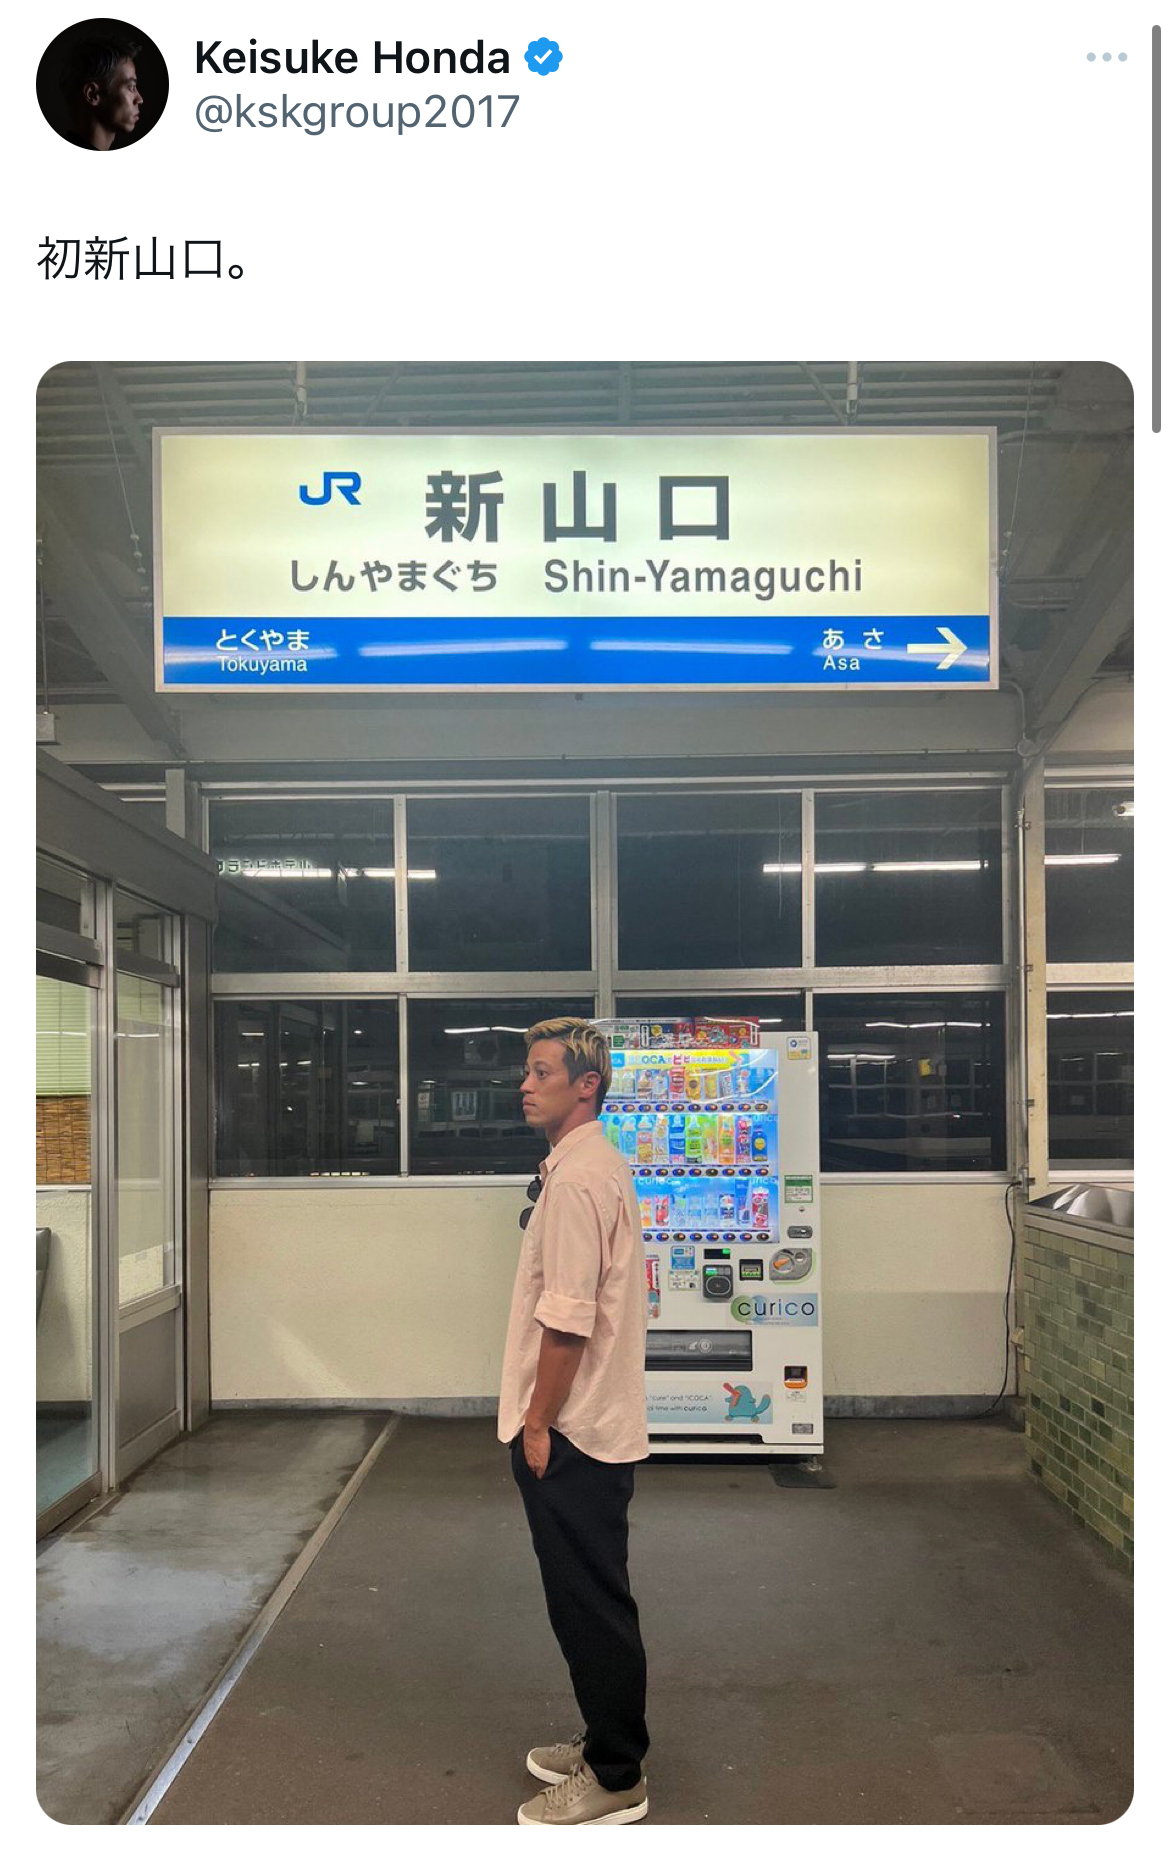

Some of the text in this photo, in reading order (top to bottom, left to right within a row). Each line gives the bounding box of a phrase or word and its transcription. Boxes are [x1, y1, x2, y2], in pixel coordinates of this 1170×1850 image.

[299, 471, 363, 506] JR
[424, 470, 730, 542] 新山口
[291, 559, 498, 593] しんやまぐち
[544, 558, 862, 601] Shin-Yamaguchi
[215, 628, 311, 652] とくやま
[823, 628, 885, 651] あさ
[218, 655, 308, 676] Tokuyama
[823, 655, 861, 671] Asa
[738, 1299, 814, 1316] curico
